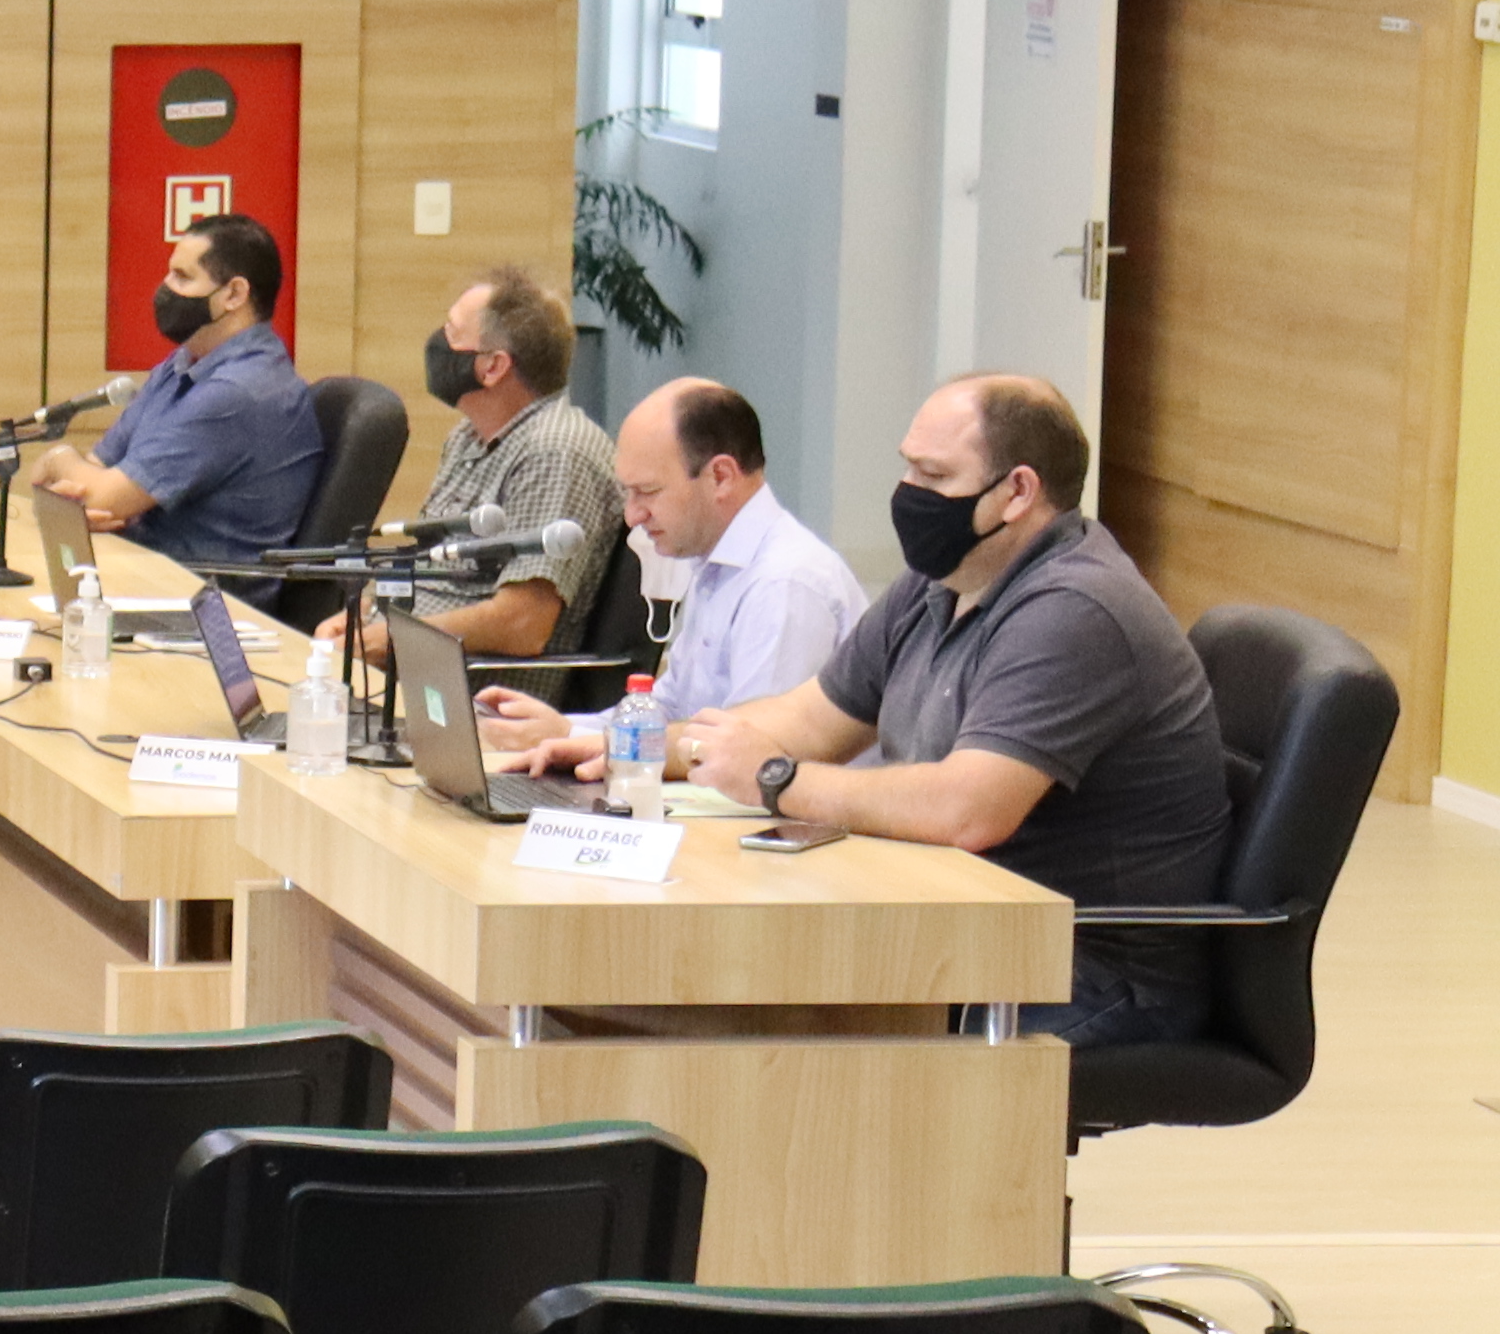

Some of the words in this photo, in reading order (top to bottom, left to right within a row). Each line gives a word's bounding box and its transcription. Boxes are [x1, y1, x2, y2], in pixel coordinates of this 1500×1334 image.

[165, 101, 225, 119] INCÊNDIO
[139, 746, 206, 762] MARCOS
[530, 822, 599, 842] ROMULO
